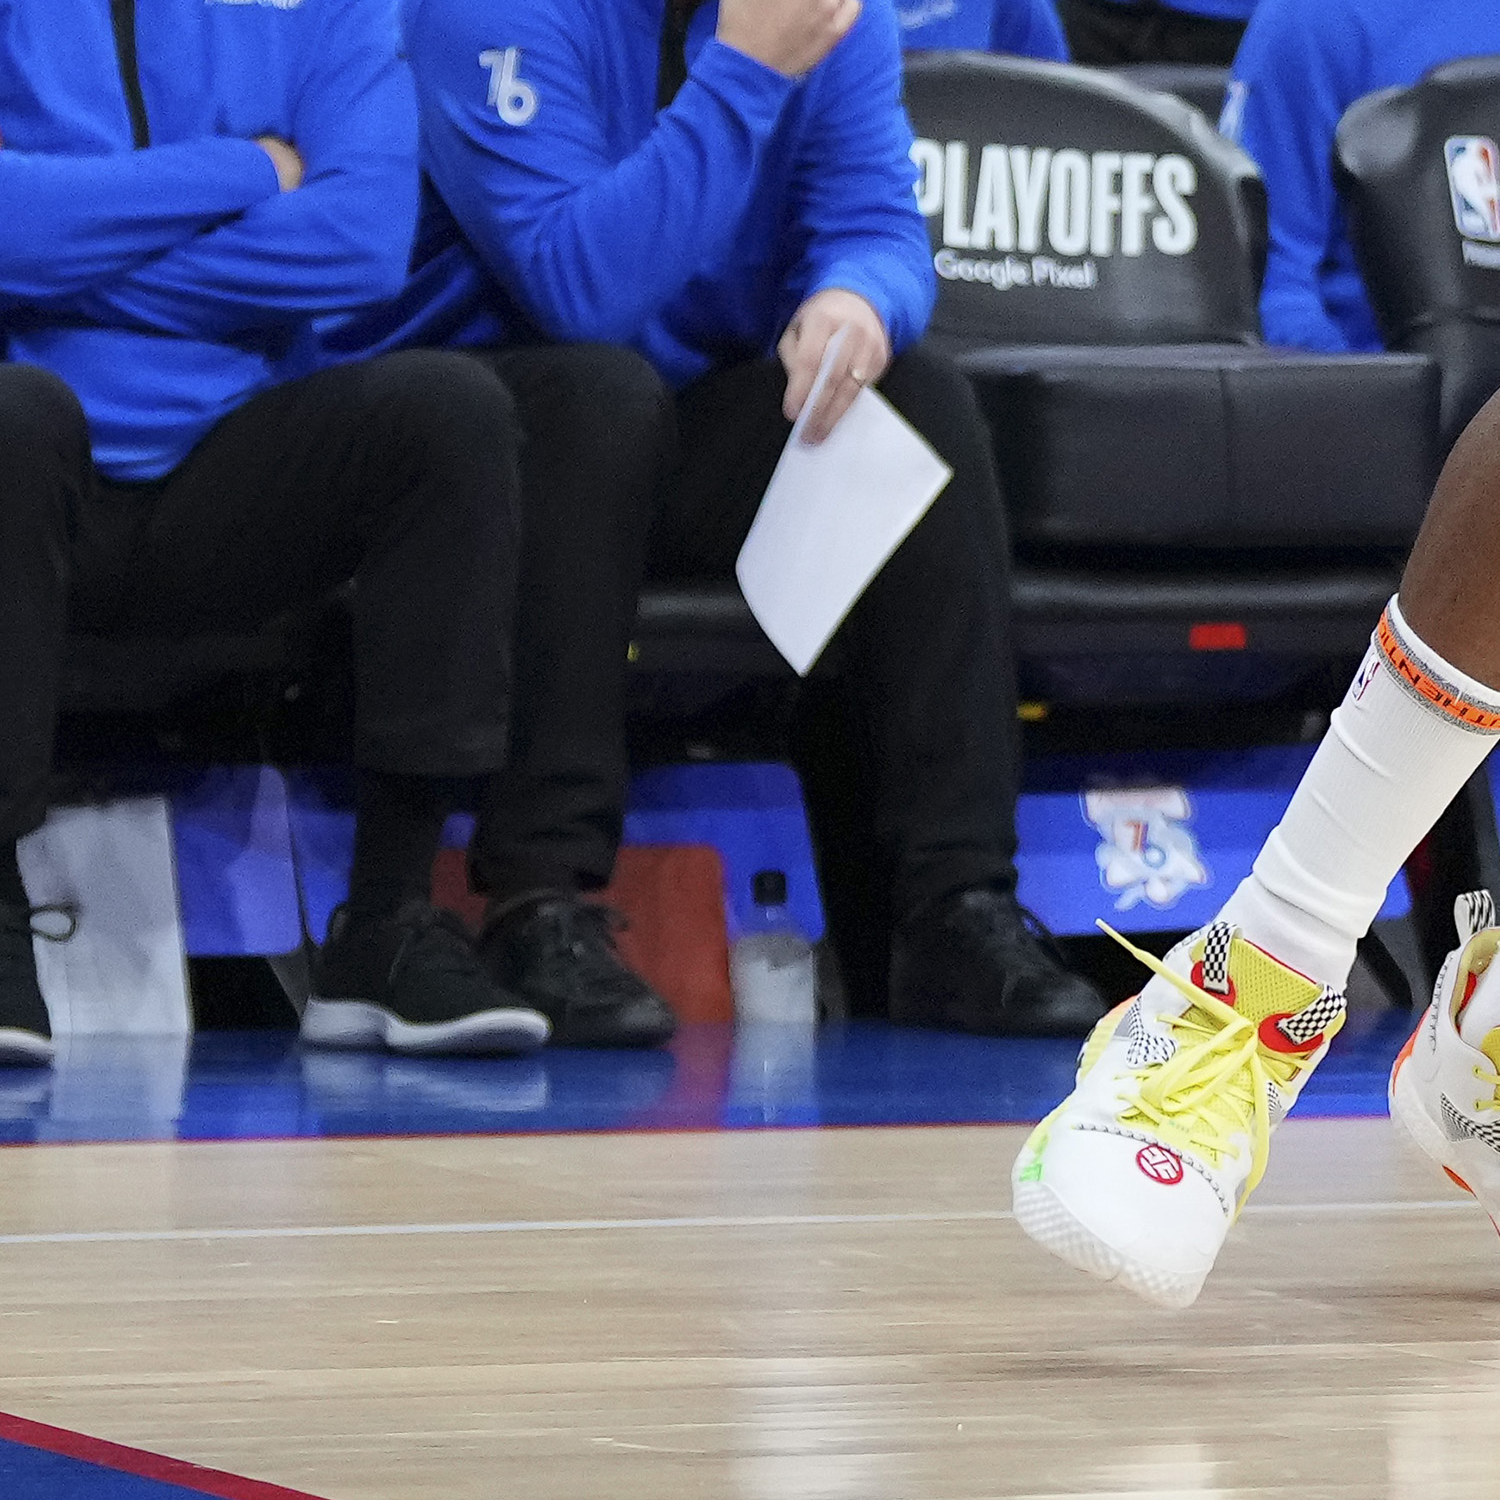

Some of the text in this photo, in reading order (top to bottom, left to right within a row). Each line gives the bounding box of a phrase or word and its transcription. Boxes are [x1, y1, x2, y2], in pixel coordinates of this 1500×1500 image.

[479, 46, 537, 127] 76
[908, 138, 1199, 257] PLAYOFFS
[933, 250, 1032, 291] Google
